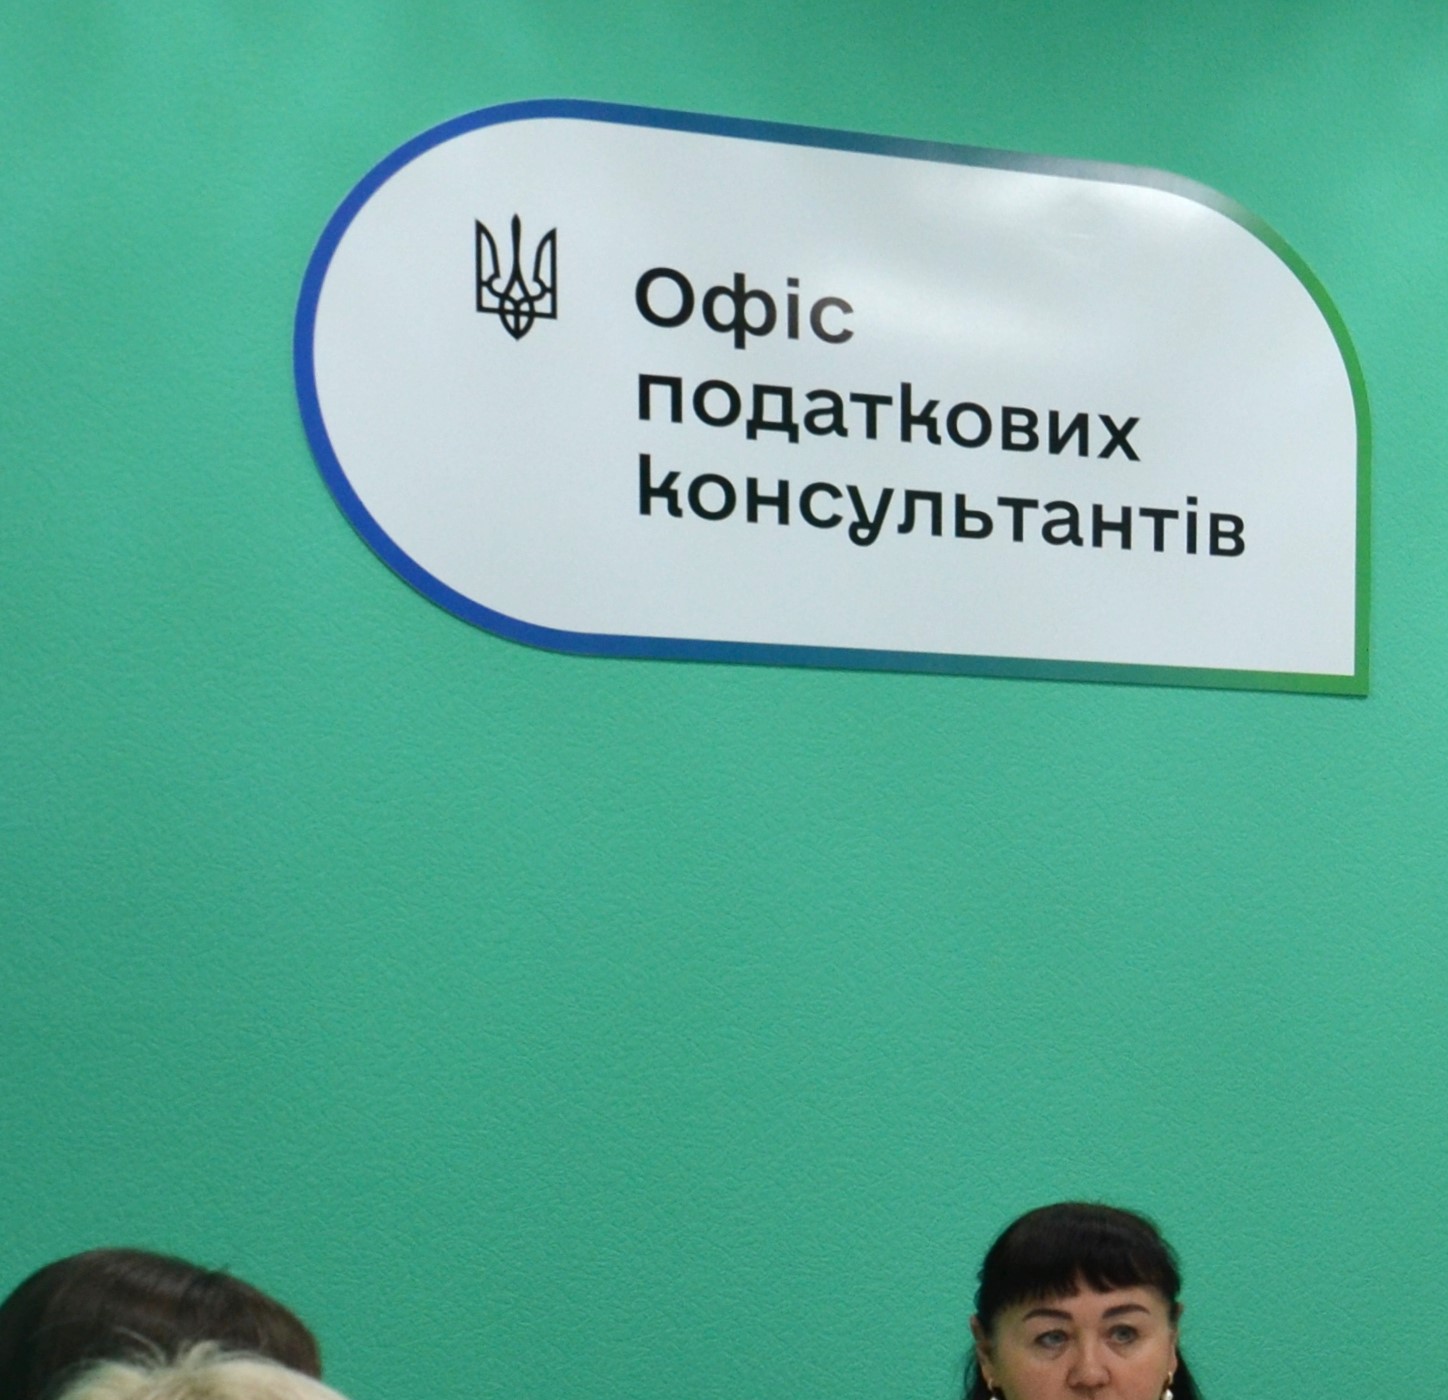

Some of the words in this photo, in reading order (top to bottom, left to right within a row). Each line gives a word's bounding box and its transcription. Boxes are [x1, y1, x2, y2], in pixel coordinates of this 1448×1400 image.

[634, 265, 855, 350] Офіс
[637, 372, 1141, 463] податкових
[638, 452, 1246, 558] консультантів
